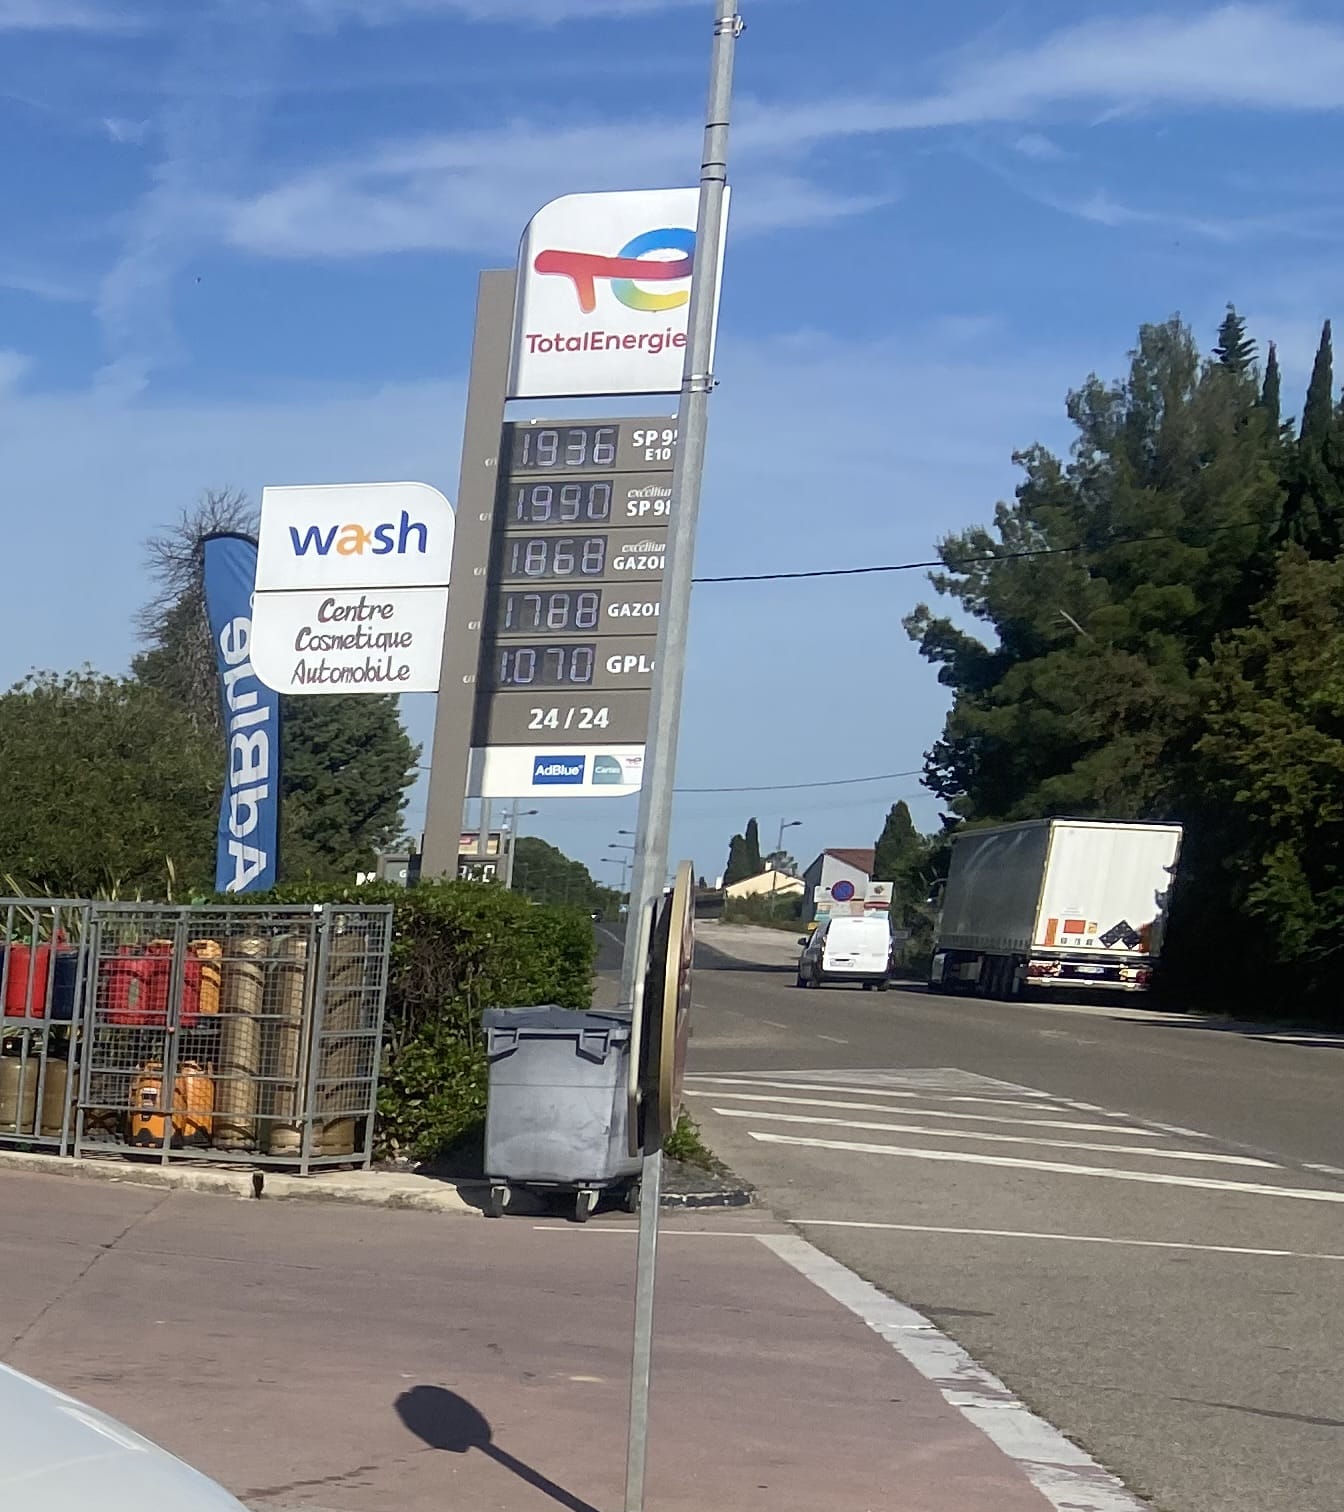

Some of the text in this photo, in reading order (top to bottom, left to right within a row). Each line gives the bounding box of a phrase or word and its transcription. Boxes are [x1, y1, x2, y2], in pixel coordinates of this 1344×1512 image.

[526, 327, 687, 354] TotalEnergie
[632, 430, 658, 447] SP
[645, 448, 671, 461] E10
[626, 501, 651, 517] SP
[288, 510, 428, 556] wash
[317, 595, 394, 623] Centre
[295, 624, 413, 652] Cosmetique
[291, 655, 411, 685] Automobile
[528, 708, 559, 730] 24
[578, 708, 610, 729] 24
